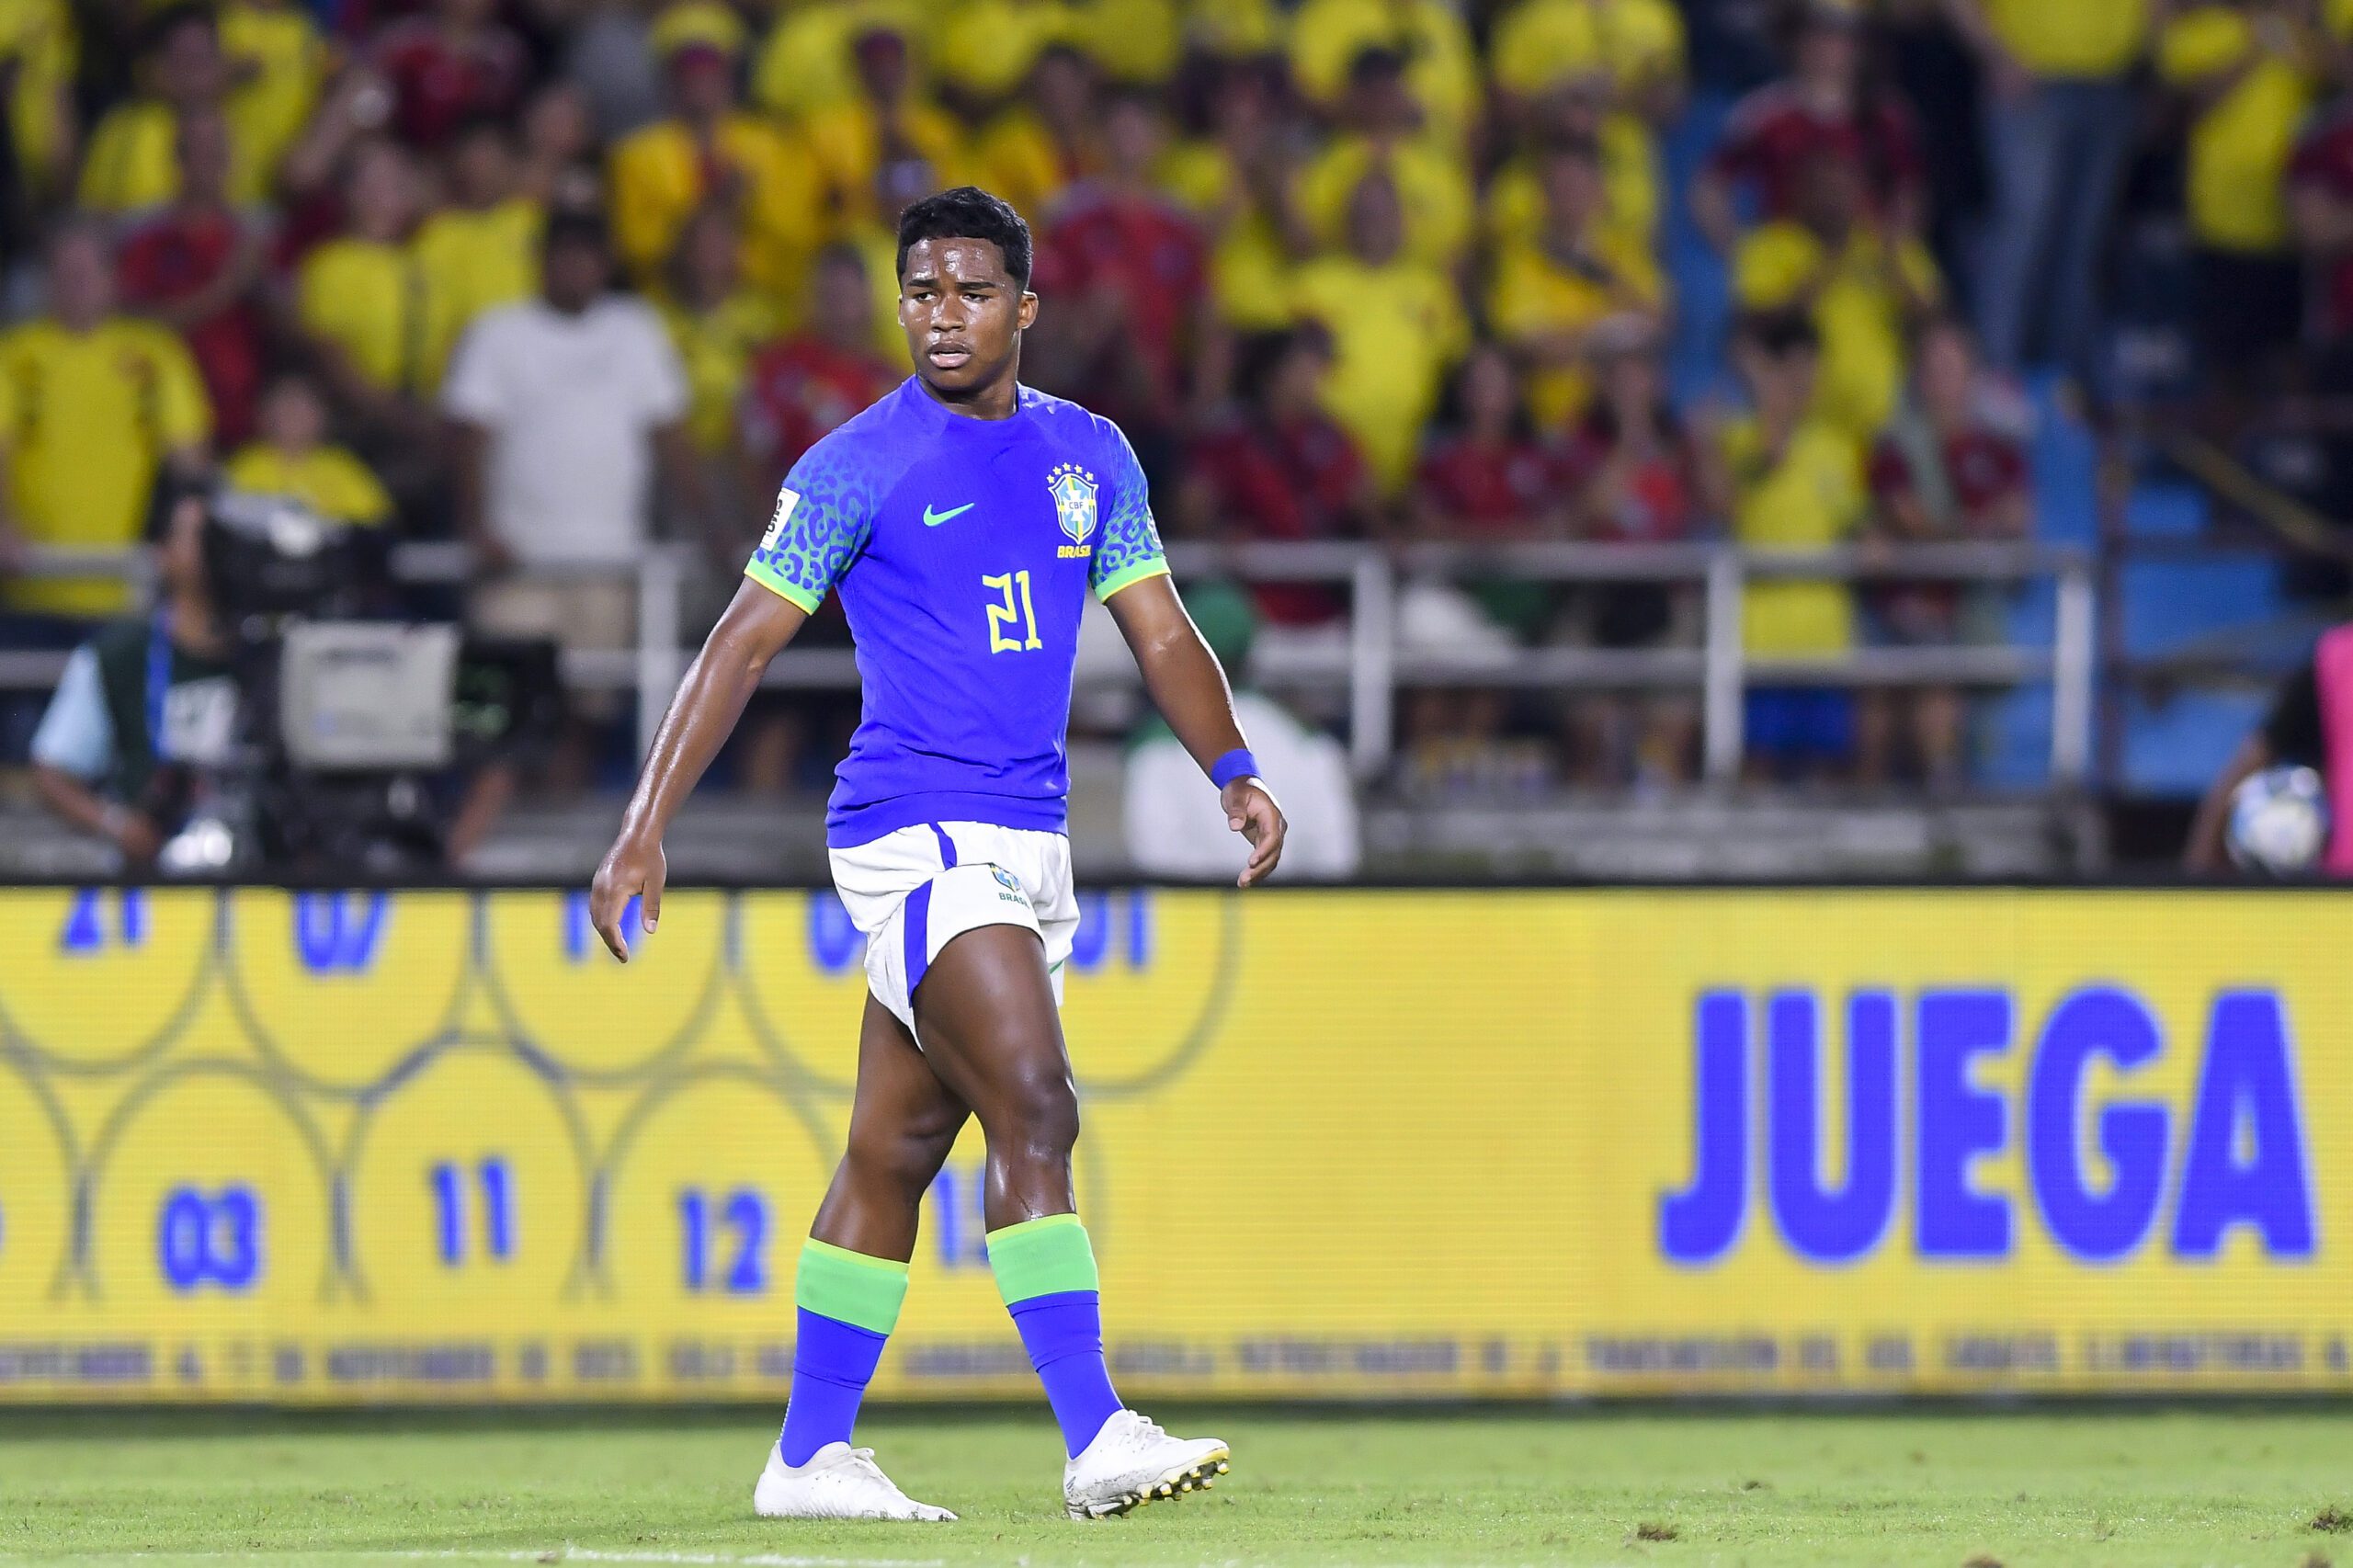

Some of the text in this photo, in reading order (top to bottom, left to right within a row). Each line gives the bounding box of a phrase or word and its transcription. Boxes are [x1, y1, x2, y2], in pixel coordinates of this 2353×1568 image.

[1068, 501, 1084, 510] CBF
[982, 570, 1042, 654] 21
[1658, 985, 2316, 1265] JUEGA
[429, 1154, 518, 1267] 11
[678, 1187, 770, 1293] 12
